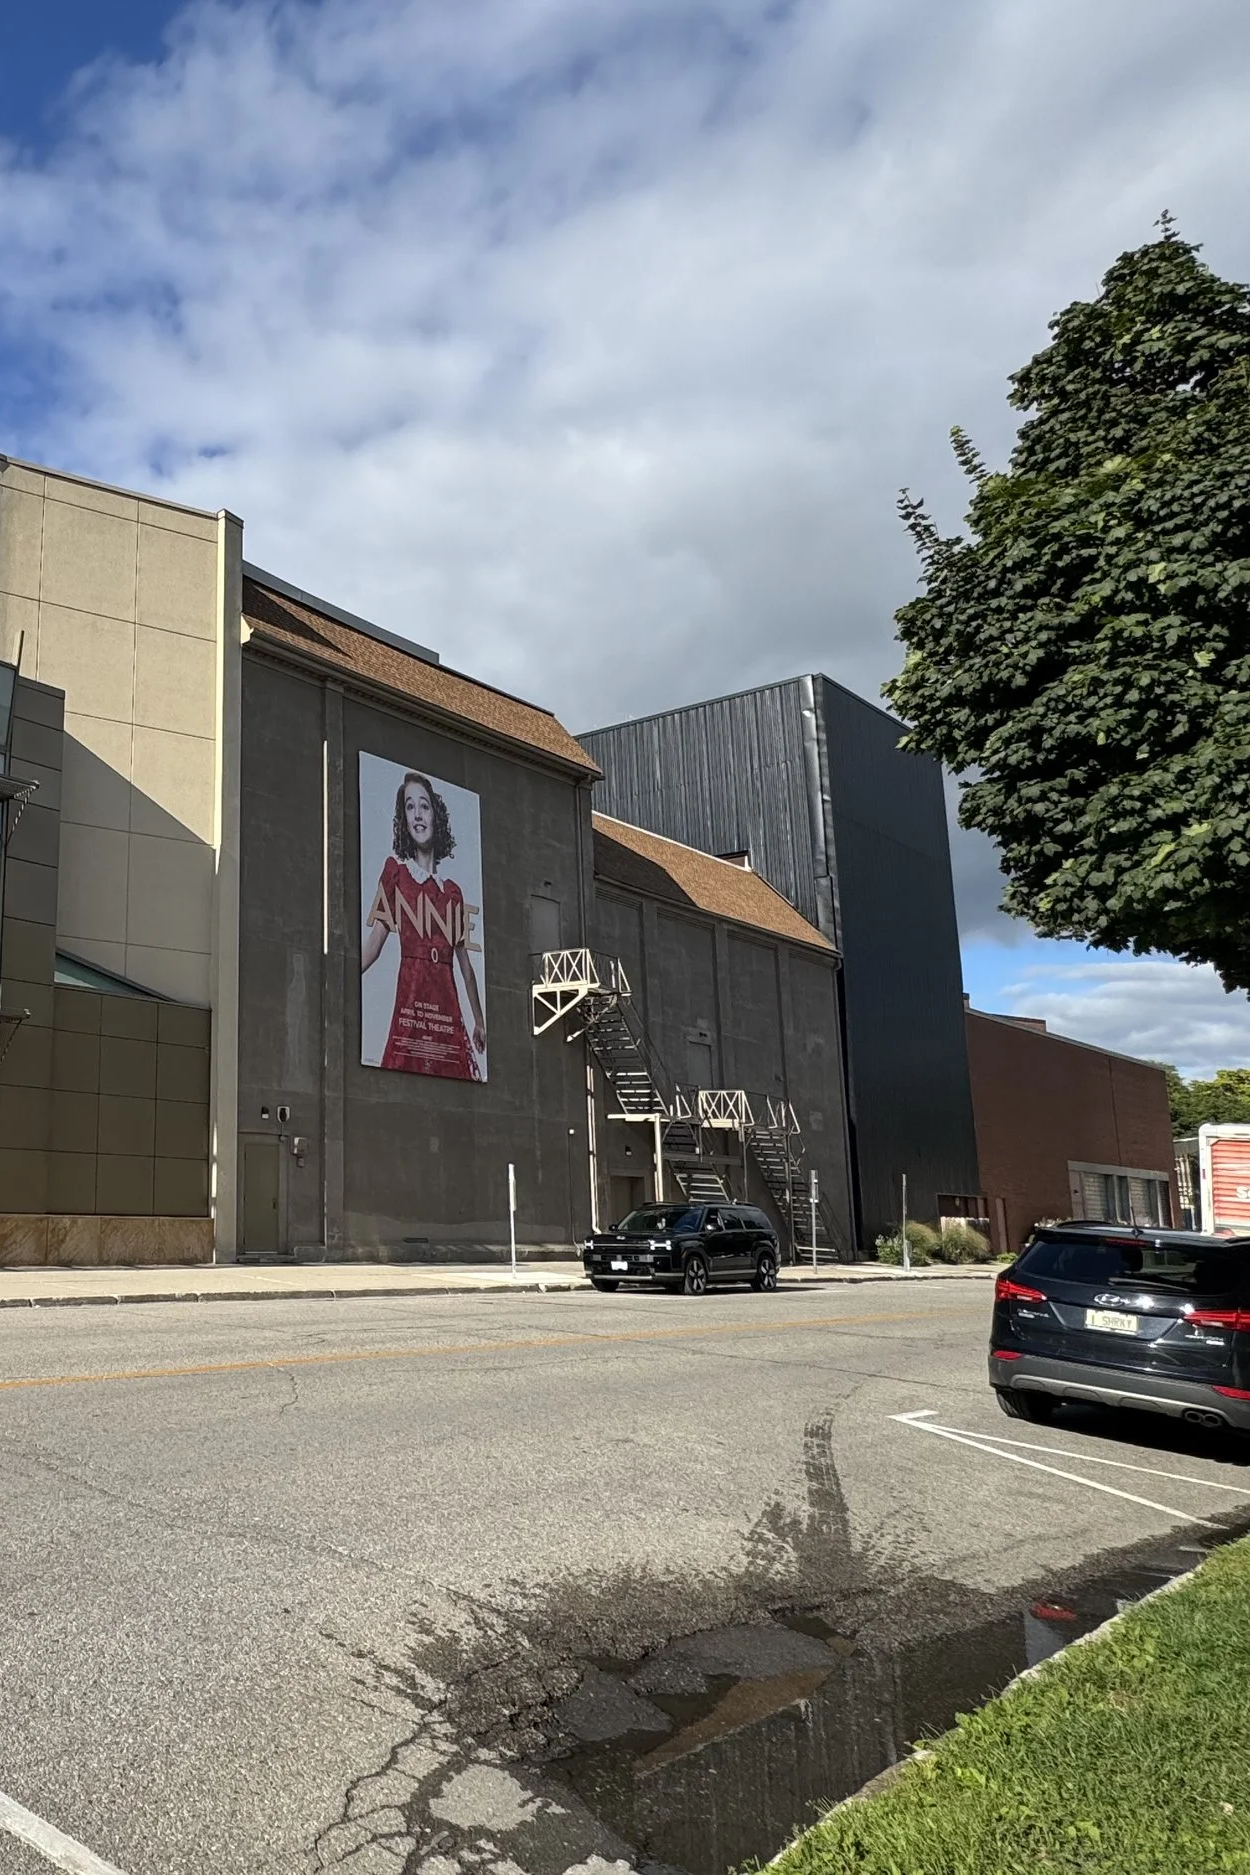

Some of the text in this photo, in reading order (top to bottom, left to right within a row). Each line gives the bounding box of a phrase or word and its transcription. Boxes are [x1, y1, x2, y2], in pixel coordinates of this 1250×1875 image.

[366, 881, 482, 952] ANNIE
[401, 1007, 454, 1023] APRIL TO NOVEMBER
[414, 1001, 440, 1012] ON STAGE
[399, 1017, 456, 1035] FESTIVAL THEATRE
